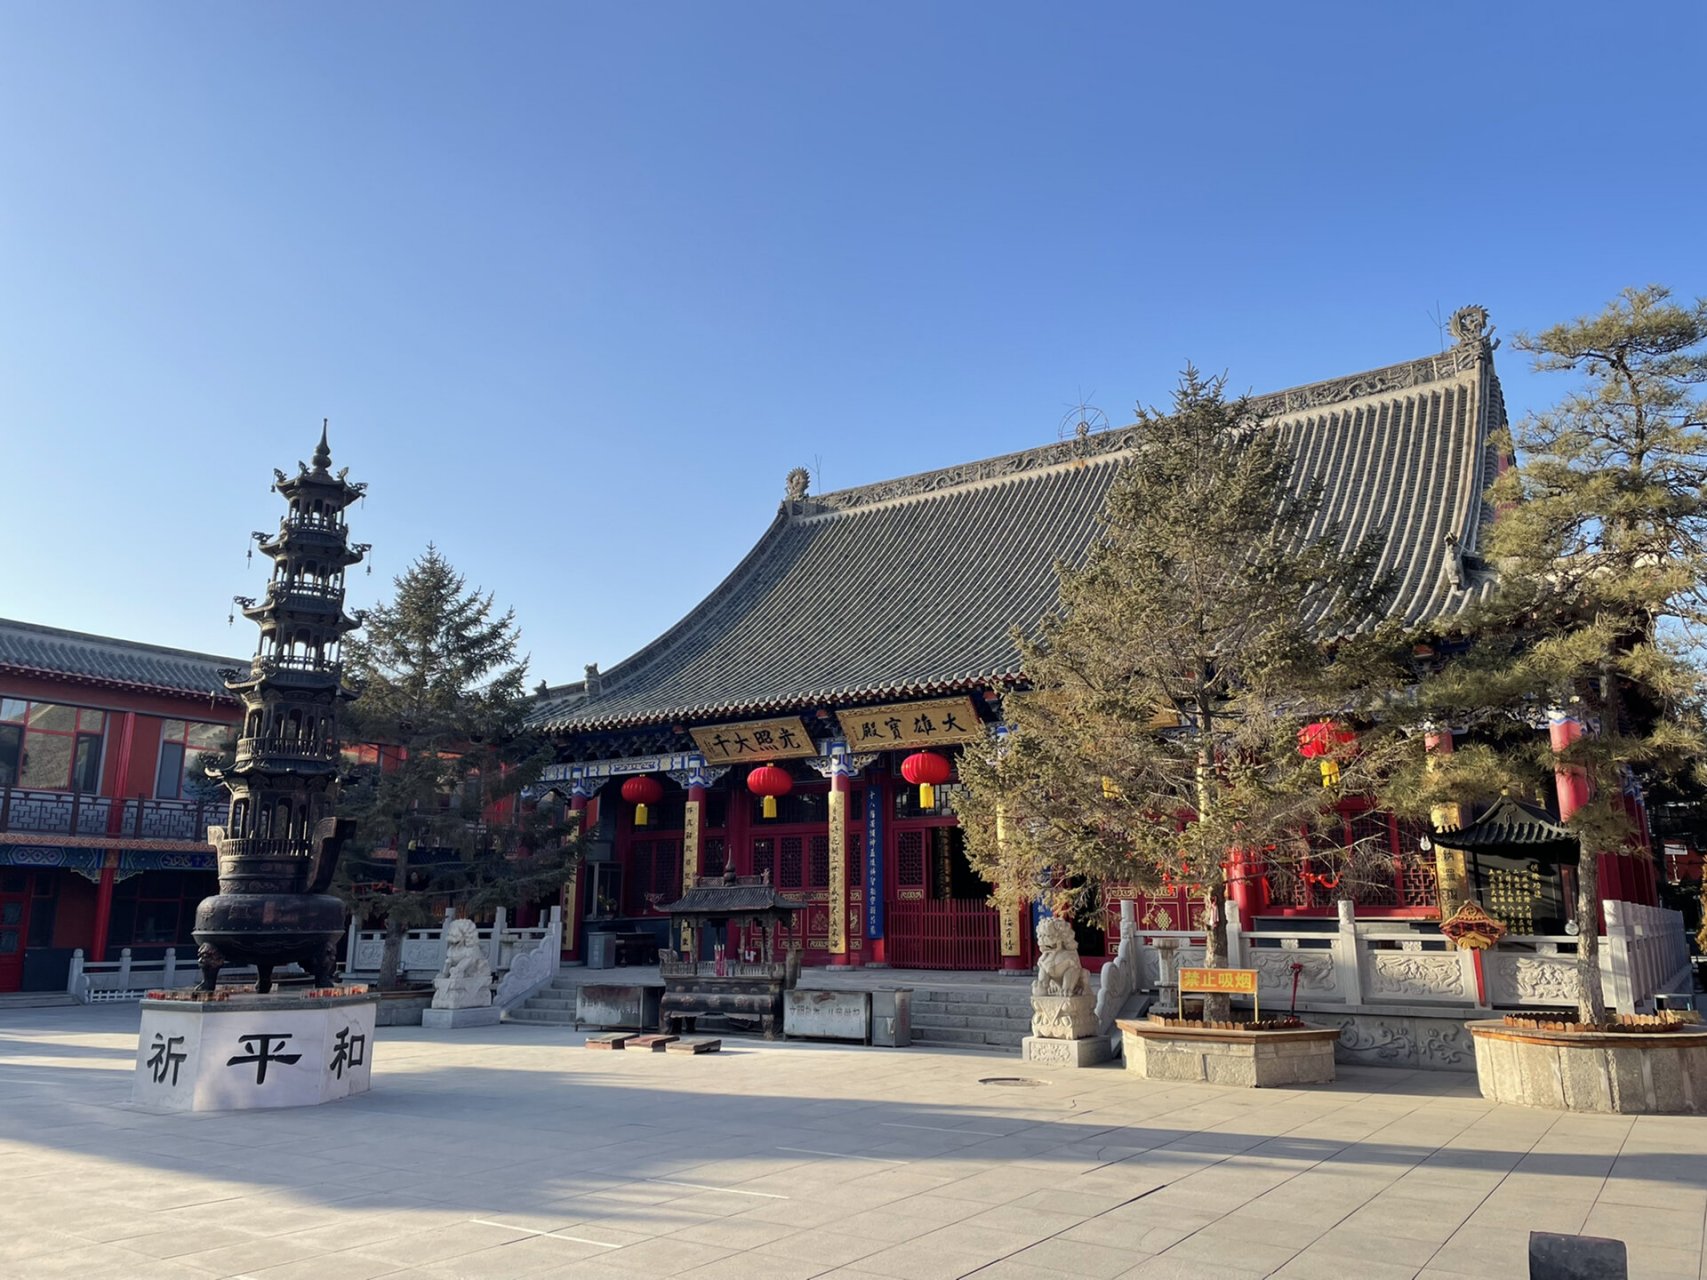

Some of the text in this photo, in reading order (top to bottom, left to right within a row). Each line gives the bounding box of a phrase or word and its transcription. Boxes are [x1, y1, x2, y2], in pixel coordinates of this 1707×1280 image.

[860, 712, 967, 740] 大雄寶殿
[713, 727, 801, 757] 光照大千
[1183, 970, 1252, 989] 禁止吸烟
[147, 1026, 366, 1087] 祈 平 和
